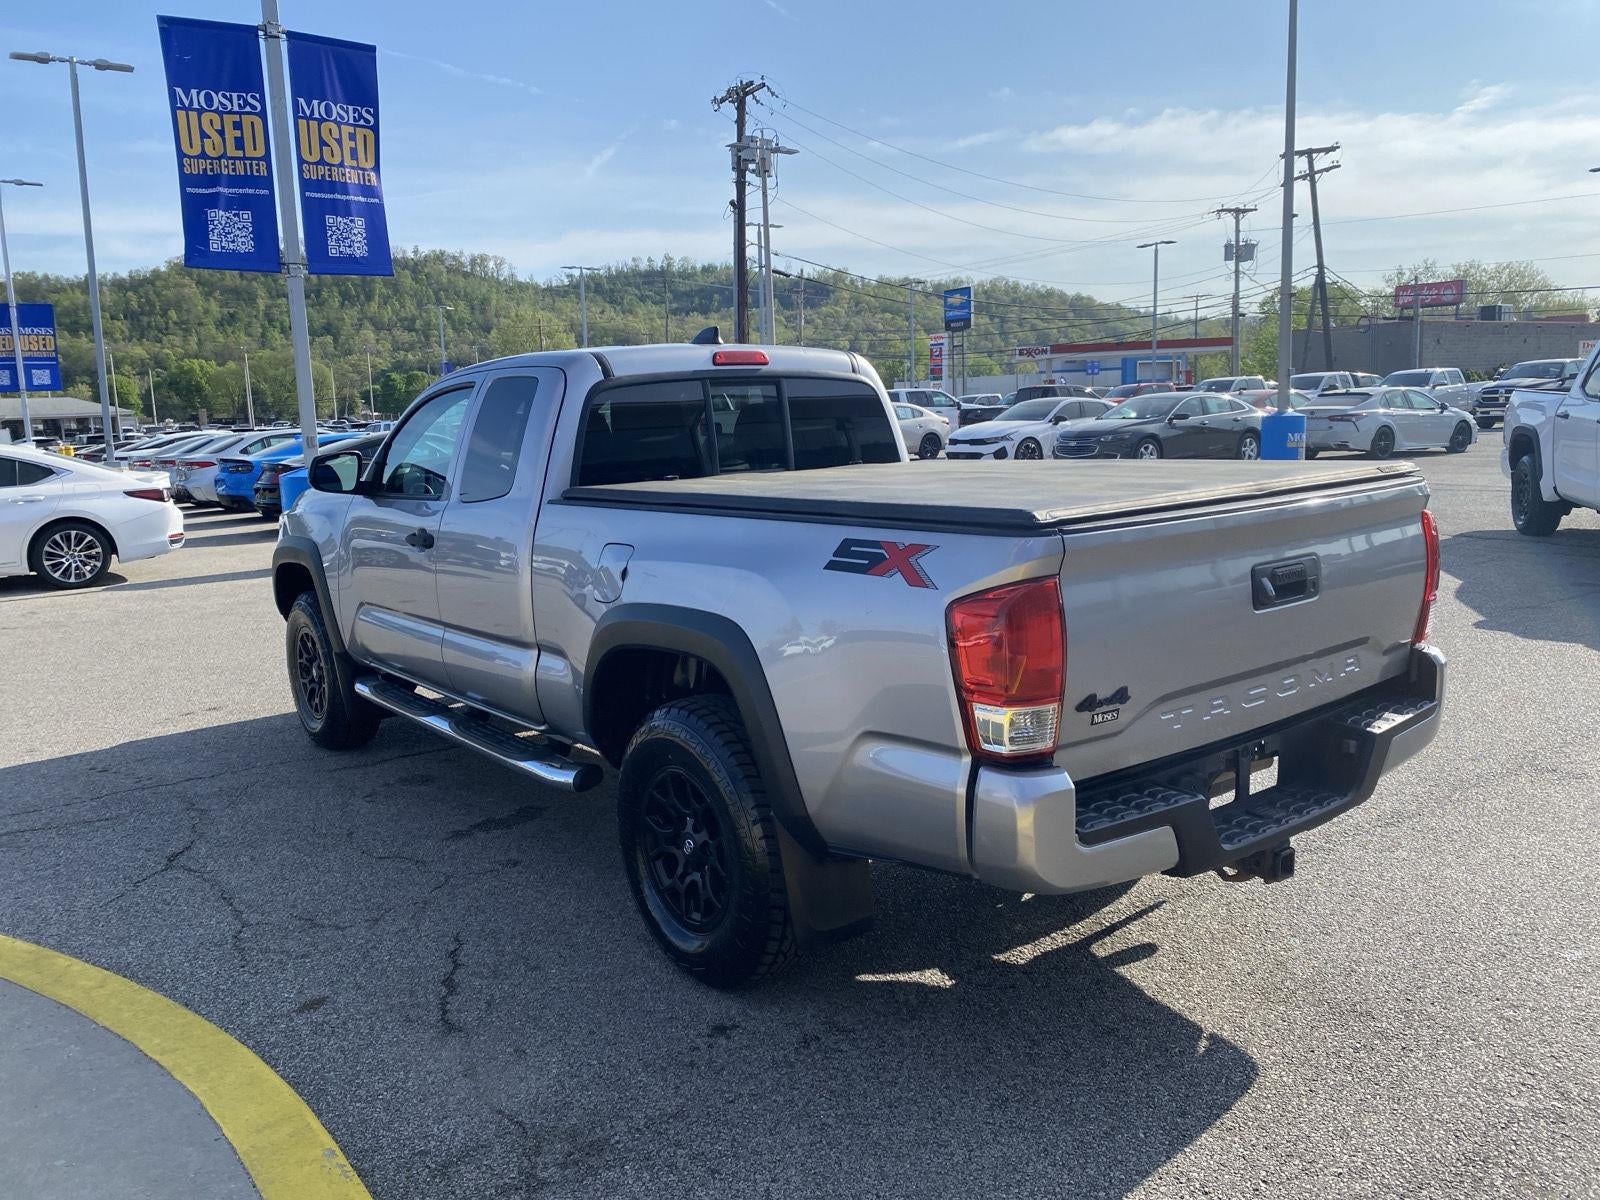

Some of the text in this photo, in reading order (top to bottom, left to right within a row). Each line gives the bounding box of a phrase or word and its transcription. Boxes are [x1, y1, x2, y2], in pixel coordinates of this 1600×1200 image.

[174, 87, 261, 112] MOSES
[297, 98, 375, 126] MOSES
[176, 110, 265, 157] USED
[297, 119, 375, 169] USED
[183, 158, 267, 176] SUPERCENTER
[302, 164, 377, 186] SUPERCENTER
[18, 327, 54, 335] MOSES
[20, 335, 55, 351] USED
[1018, 347, 1048, 358] EXXON
[1161, 655, 1361, 729] TACOMA
[1092, 710, 1119, 724] MOSES
